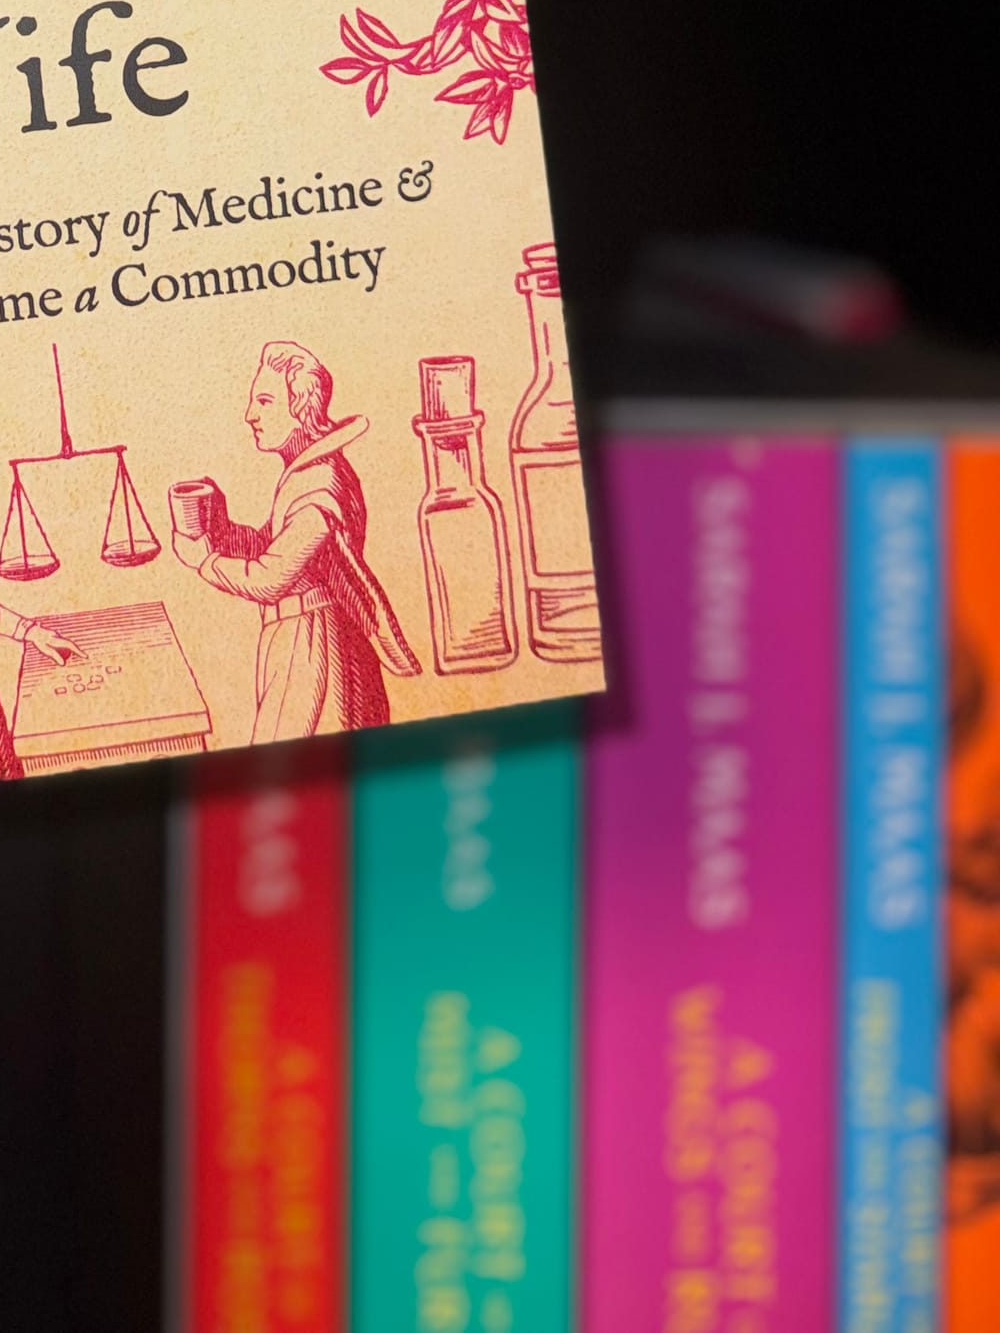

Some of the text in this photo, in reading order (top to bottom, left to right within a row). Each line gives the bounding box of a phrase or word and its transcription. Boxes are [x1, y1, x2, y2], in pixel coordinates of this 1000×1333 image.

[122, 190, 170, 242] of
[169, 171, 384, 233] Medicine
[396, 160, 434, 203] &
[74, 286, 99, 313] a
[111, 241, 386, 308] Commodity
